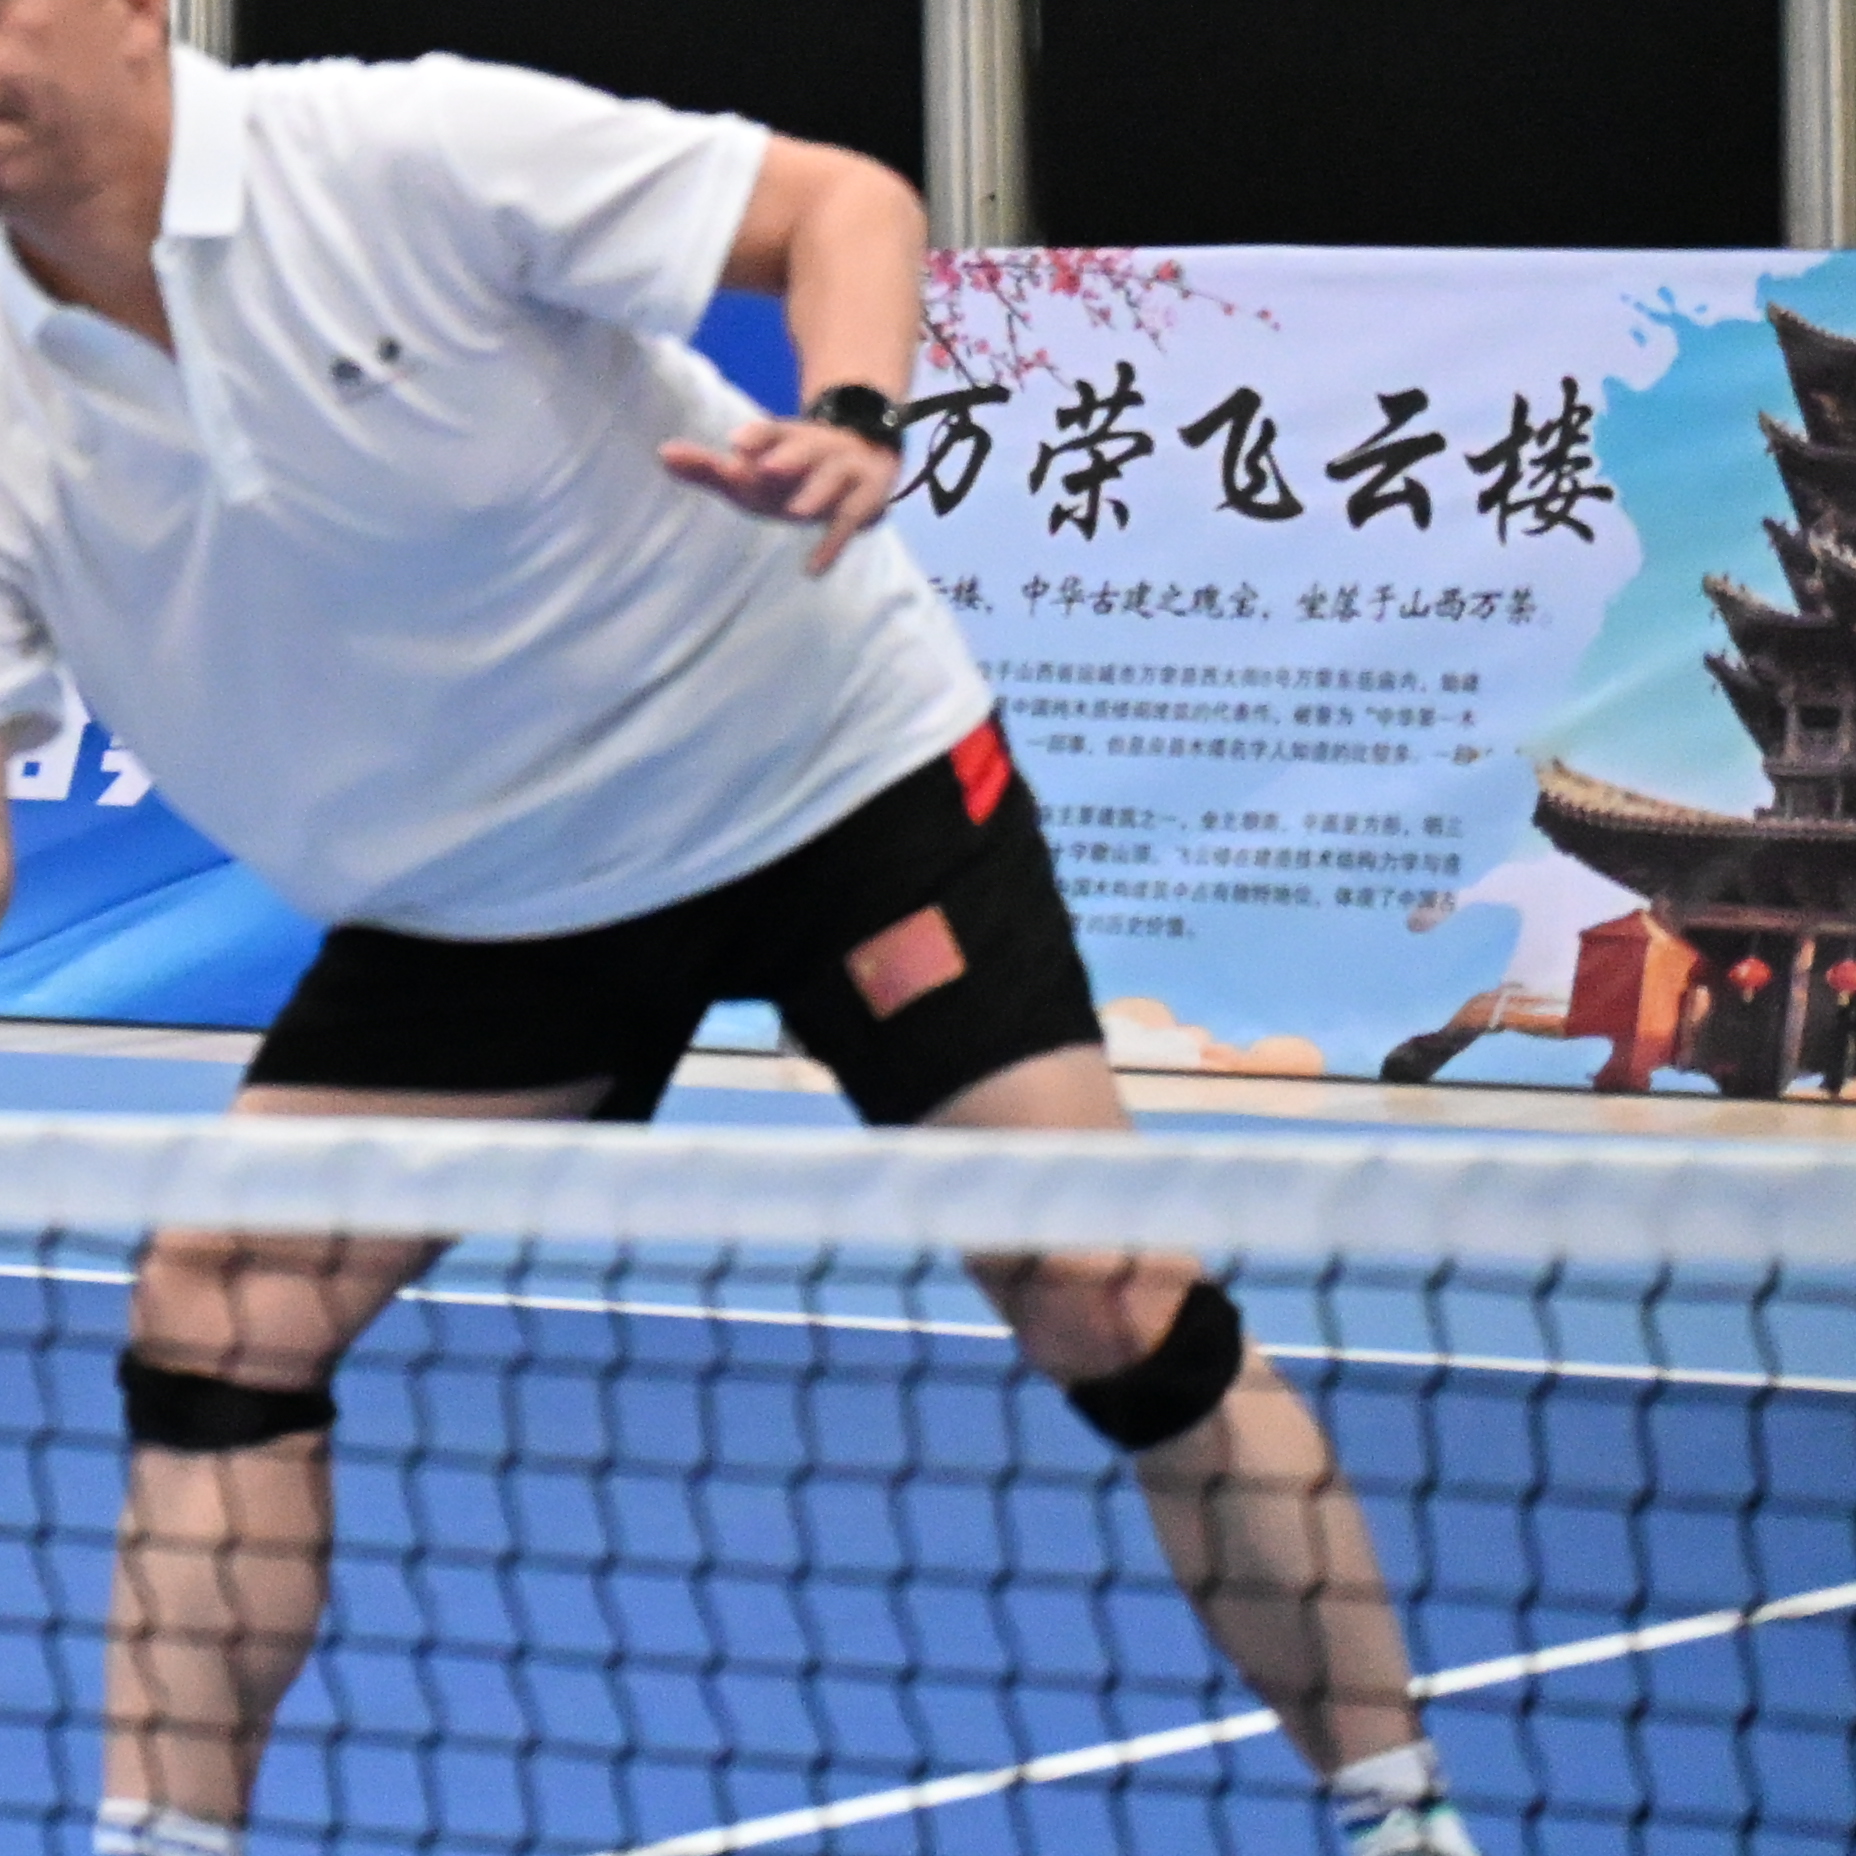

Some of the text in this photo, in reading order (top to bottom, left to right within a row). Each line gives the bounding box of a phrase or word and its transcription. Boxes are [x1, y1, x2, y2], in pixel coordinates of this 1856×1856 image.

[890, 360, 1615, 546] 万荣飞云楼
